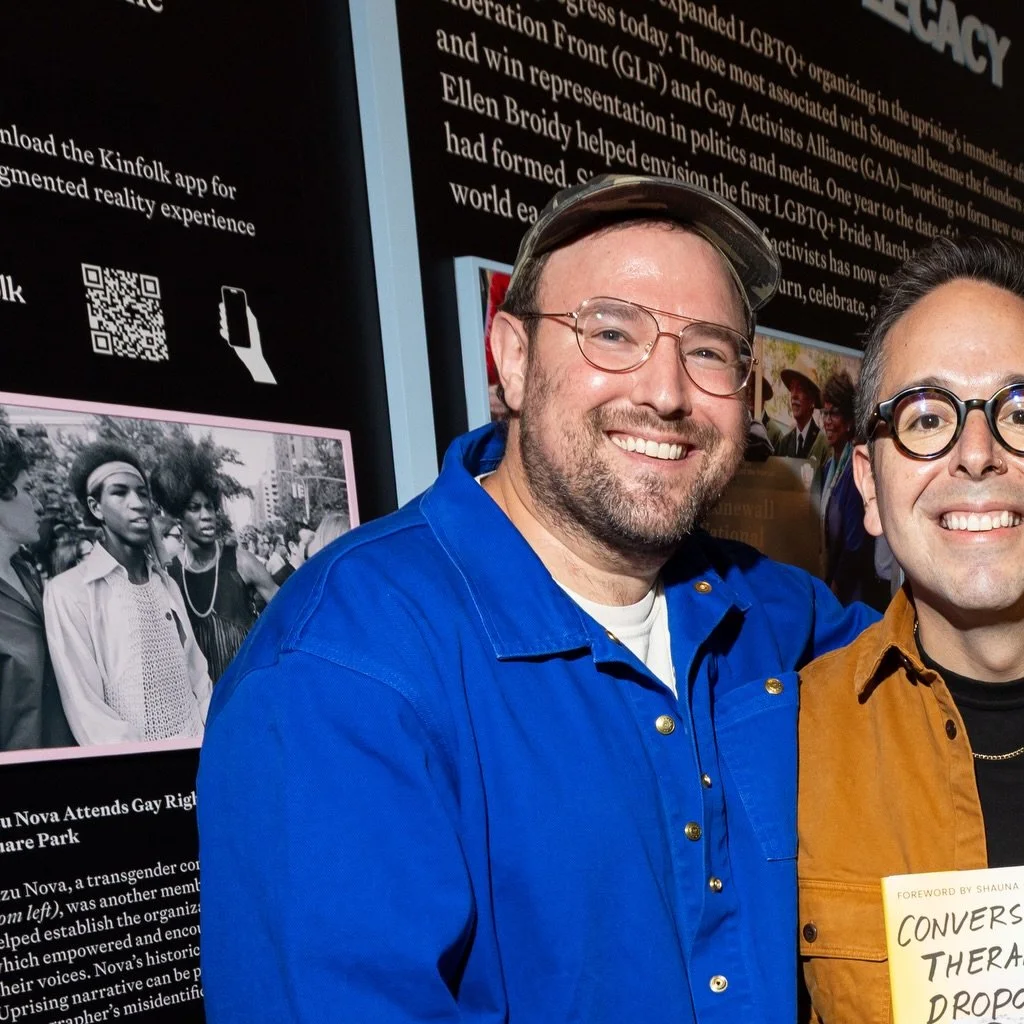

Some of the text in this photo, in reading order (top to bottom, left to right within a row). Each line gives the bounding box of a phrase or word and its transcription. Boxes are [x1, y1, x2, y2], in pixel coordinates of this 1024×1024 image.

[861, 0, 1011, 88] GACY
[442, 0, 548, 44] eration
[552, 18, 608, 69] Front
[612, 45, 667, 96] (GLF)
[671, 78, 701, 108] and
[704, 88, 736, 127] Gay
[740, 103, 803, 150] Activists
[806, 131, 858, 172] Alliance
[955, 200, 966, 218] to
[967, 200, 990, 229] form
[992, 216, 1009, 238] new
[560, 0, 616, 27] gress
[619, 8, 673, 57] today.
[675, 31, 726, 77] Those
[729, 63, 766, 96] most
[769, 81, 838, 128] associated
[840, 113, 868, 142] with
[869, 123, 924, 169] Stonewall
[926, 147, 964, 187] became
[966, 168, 981, 194] the
[983, 175, 1022, 212] founders
[740, 20, 806, 78] LGBTQ+
[808, 62, 876, 115] organizing
[877, 90, 890, 117] in
[891, 99, 910, 127] the
[963, 134, 1012, 176] immediate
[436, 28, 480, 64] and
[482, 45, 525, 82] win
[529, 64, 667, 137] representation
[670, 113, 688, 144] in
[690, 127, 747, 166] politics
[750, 152, 777, 178] and
[779, 163, 824, 196] media.
[826, 177, 851, 207] One
[854, 194, 880, 216] year
[882, 201, 894, 222] to
[895, 204, 914, 230] the
[915, 212, 938, 237] date
[444, 120, 572, 188] had formed.
[61, 139, 95, 166] the
[98, 147, 172, 184] Kinfolk
[175, 172, 208, 198] app
[211, 175, 237, 200] for
[440, 71, 909, 261] Ellen Broidy helped envision the first LGBTQ+ Pride March
[94, 187, 156, 220] reality
[161, 202, 256, 237] experience
[449, 181, 513, 219] world
[770, 236, 827, 269] activists
[829, 249, 850, 277] has
[853, 267, 878, 286] now
[809, 283, 868, 320] celebrate,
[14, 811, 60, 828] Nova
[63, 799, 129, 822] Attends
[132, 798, 162, 815] Gay
[36, 828, 80, 848] Park
[23, 880, 73, 898] Nova,
[75, 878, 84, 890] a
[87, 861, 177, 888] transgender
[897, 887, 956, 900] FOREWORD
[960, 886, 972, 894] BY
[976, 881, 1019, 893] SHAUNA
[26, 900, 64, 924] left),
[66, 899, 97, 914] was
[100, 888, 157, 908] another
[44, 916, 115, 940] establish
[117, 911, 141, 928] the
[0, 927, 162, 973] hich empowered and
[38, 969, 91, 988] voices.
[146, 944, 200, 966] historic
[0, 994, 69, 1022] Uprising
[72, 980, 143, 1005] narrative
[146, 974, 172, 989] can
[174, 967, 190, 982] be
